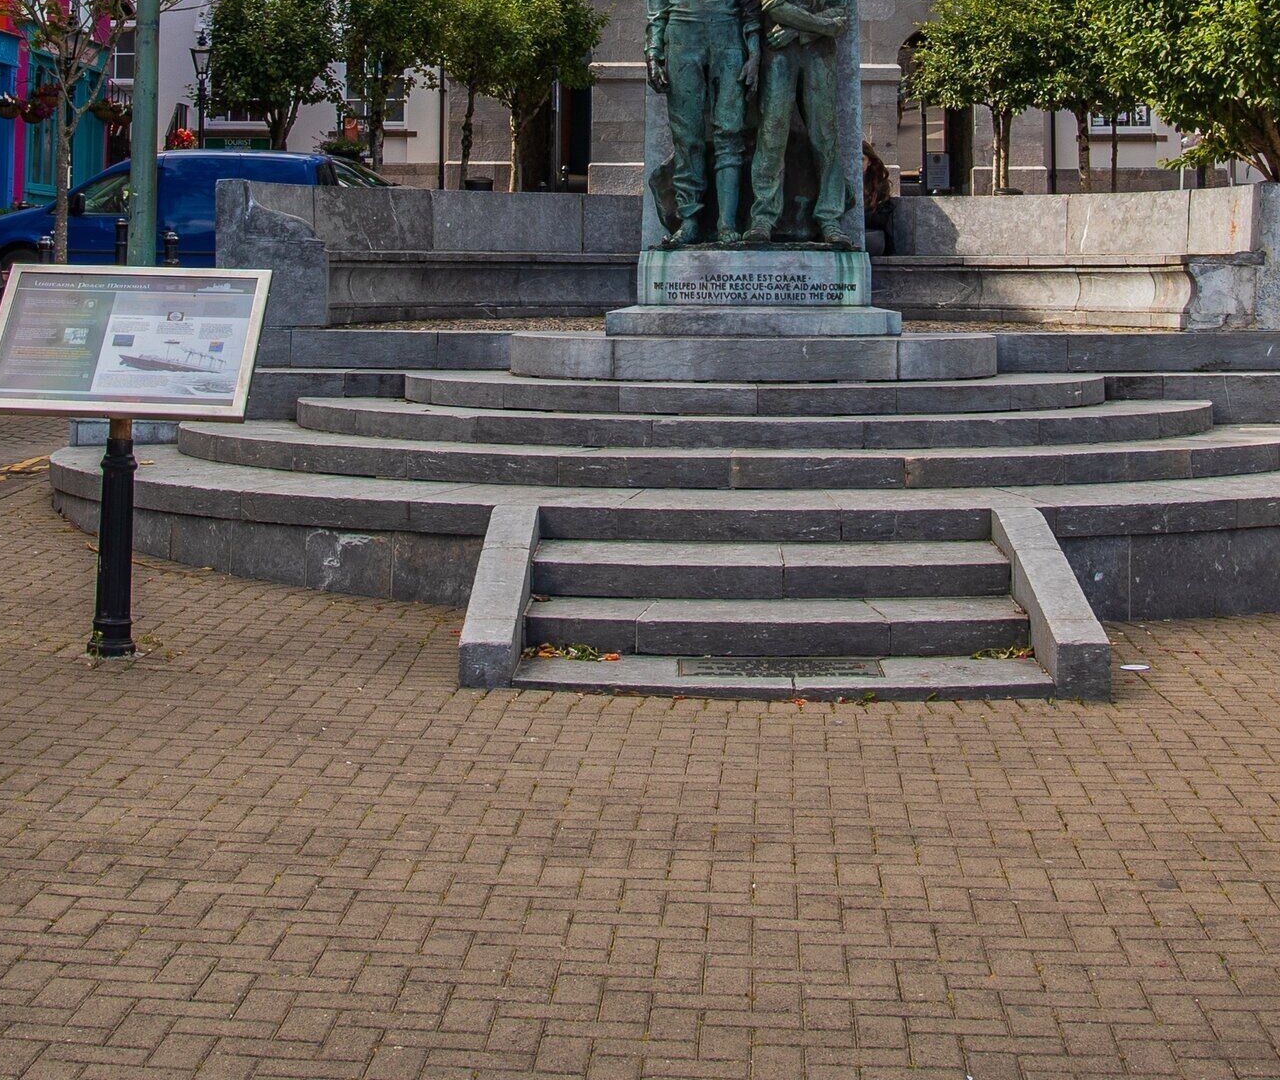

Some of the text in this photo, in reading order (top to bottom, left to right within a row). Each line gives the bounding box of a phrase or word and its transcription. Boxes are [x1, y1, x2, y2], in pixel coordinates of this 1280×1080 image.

[224, 137, 251, 146] TOURIST
[705, 274, 807, 282] LABORARE EST ORARE
[34, 280, 151, 290] Lusitania Peace Memorial
[668, 282, 697, 291] HELPED
[699, 282, 708, 291] IN
[710, 282, 727, 291] THE
[793, 282, 809, 291] AID
[809, 282, 827, 291] AND
[668, 292, 844, 300] TO THE SURVIVORS AND BURIED THE DEAD
